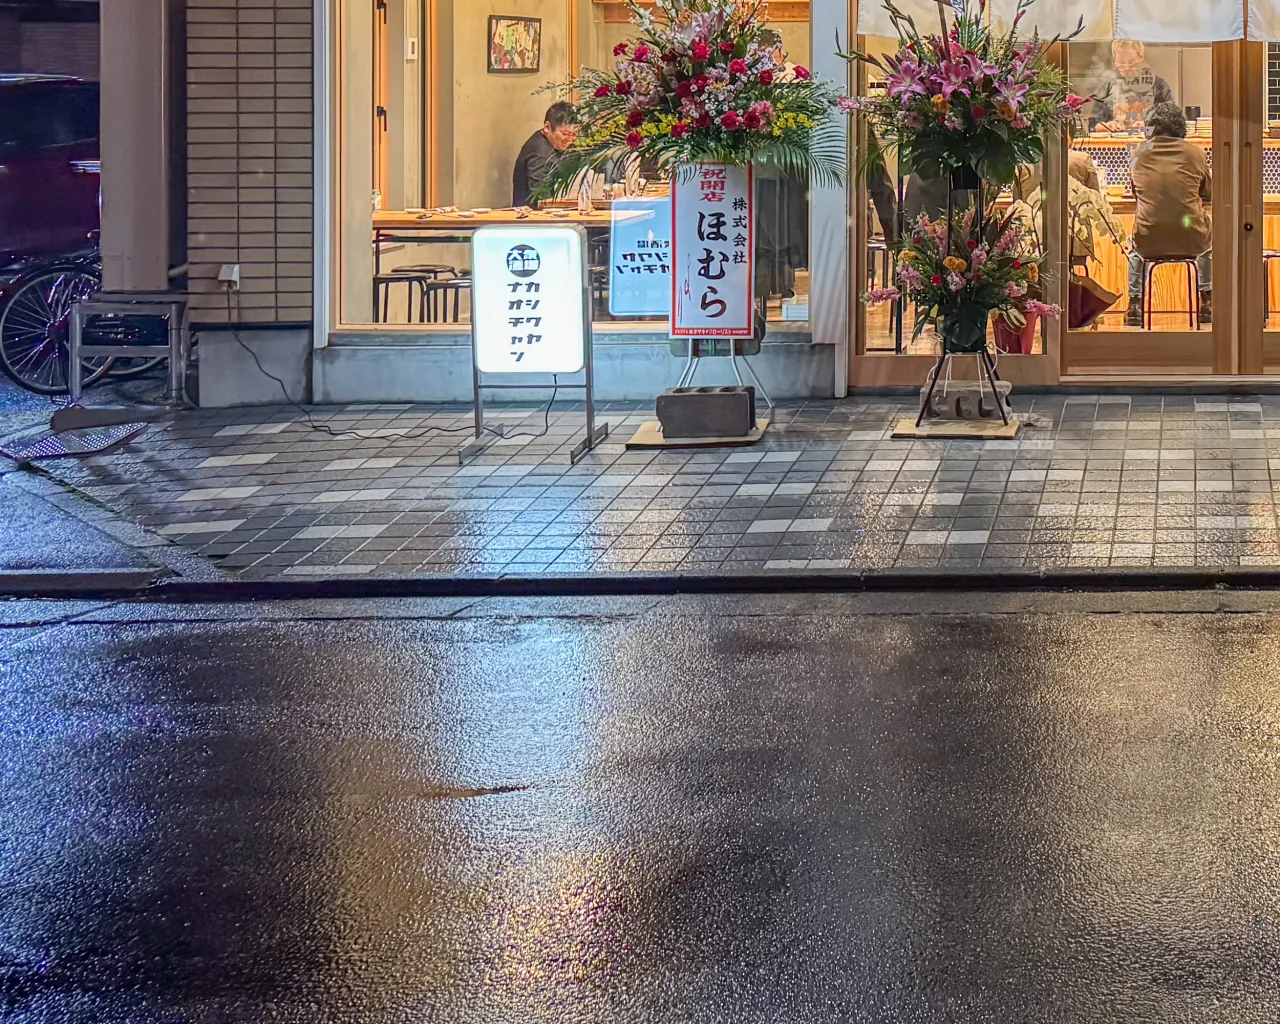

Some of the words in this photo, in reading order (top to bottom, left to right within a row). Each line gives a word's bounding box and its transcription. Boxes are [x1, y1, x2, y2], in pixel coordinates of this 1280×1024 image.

[700, 168, 727, 203] 祝開店
[732, 196, 748, 264] 株式会社
[697, 211, 730, 318] ほむら
[525, 281, 542, 345] カシワヤ
